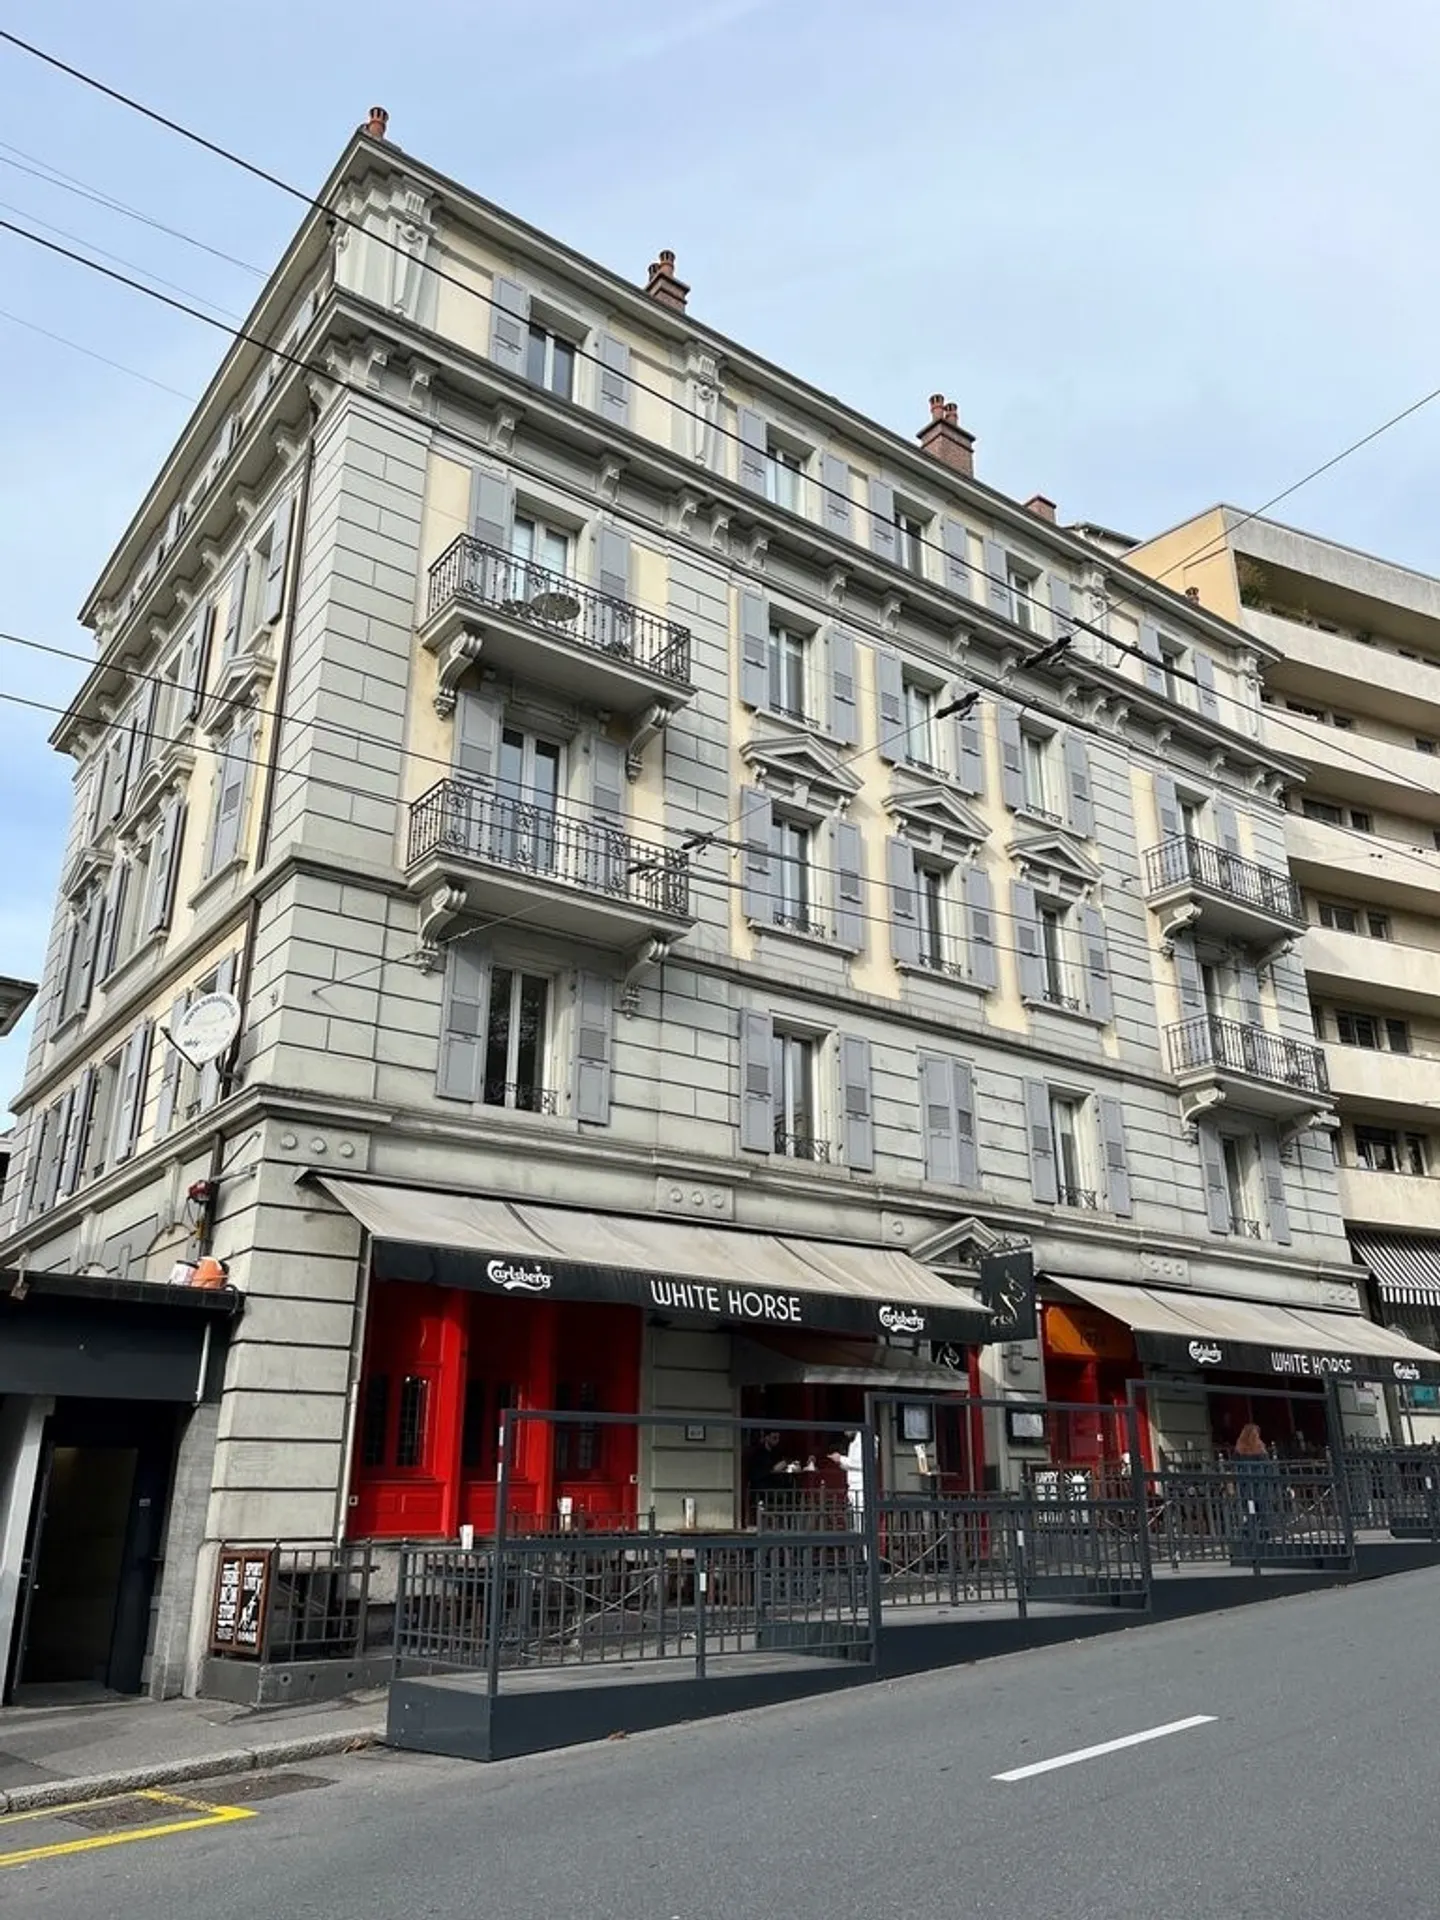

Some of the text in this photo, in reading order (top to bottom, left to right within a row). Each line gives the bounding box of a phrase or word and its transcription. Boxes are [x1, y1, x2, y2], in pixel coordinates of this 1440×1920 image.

[487, 1260, 551, 1291] Carlsberg
[650, 1280, 802, 1322] WHITE HORSE
[878, 1305, 925, 1332] Carlsberg
[1271, 1351, 1352, 1375] WHITE HORSE
